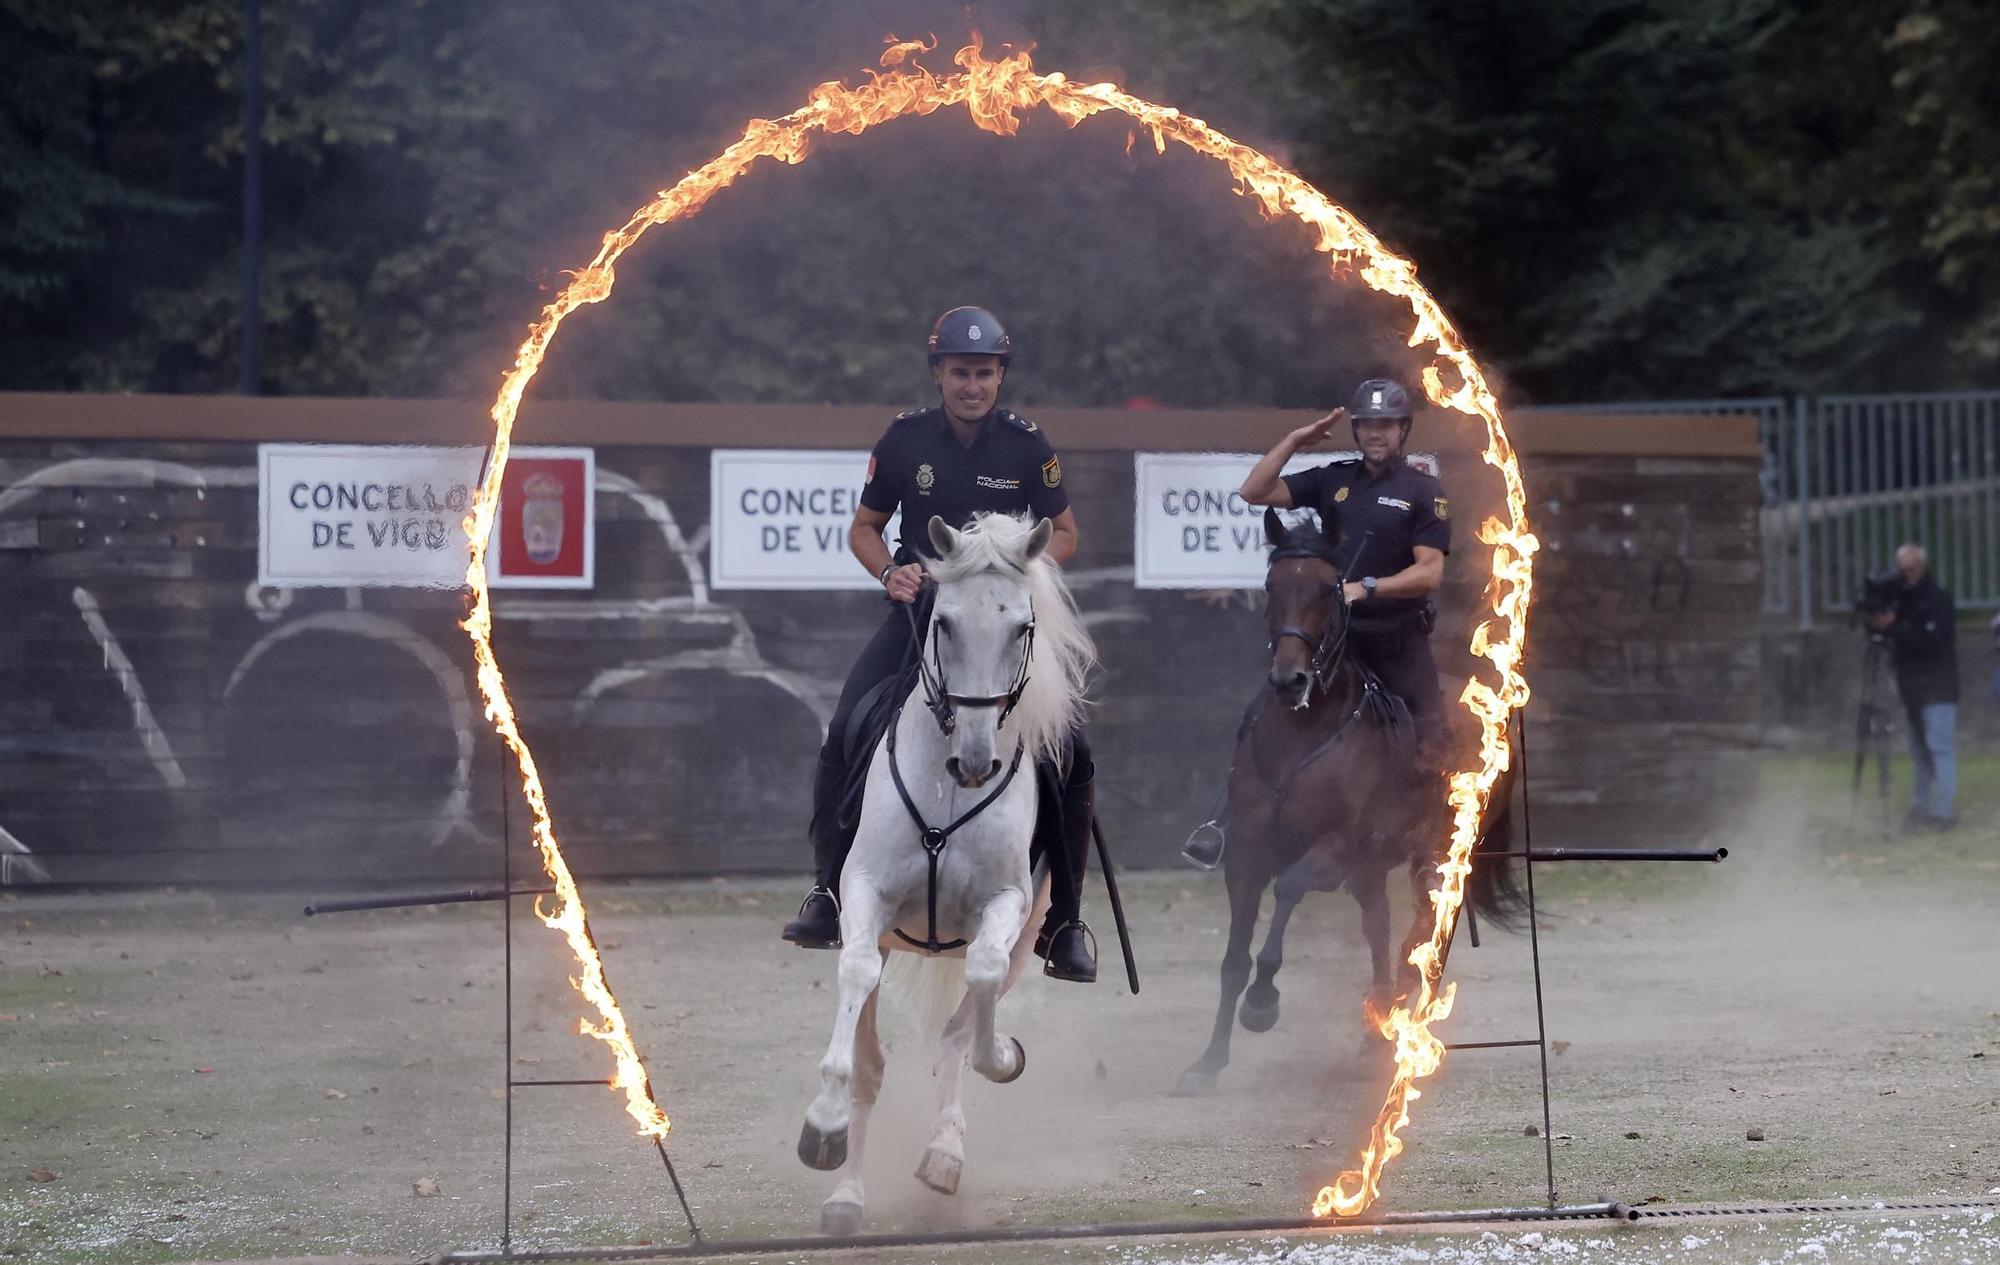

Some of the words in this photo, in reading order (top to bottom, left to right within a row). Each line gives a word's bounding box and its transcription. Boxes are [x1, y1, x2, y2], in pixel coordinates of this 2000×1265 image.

[976, 481, 1018, 489] NACIONAL
[977, 475, 1010, 484] POLICIA
[289, 483, 468, 512] CONCELLO
[740, 489, 859, 515] CONCEL
[1162, 489, 1262, 516] CONC
[313, 521, 354, 550] DE
[367, 519, 446, 550] VIGO
[762, 526, 801, 552] DE
[814, 526, 854, 552] VI
[1183, 526, 1221, 552] DE
[1231, 526, 1262, 552] VI
